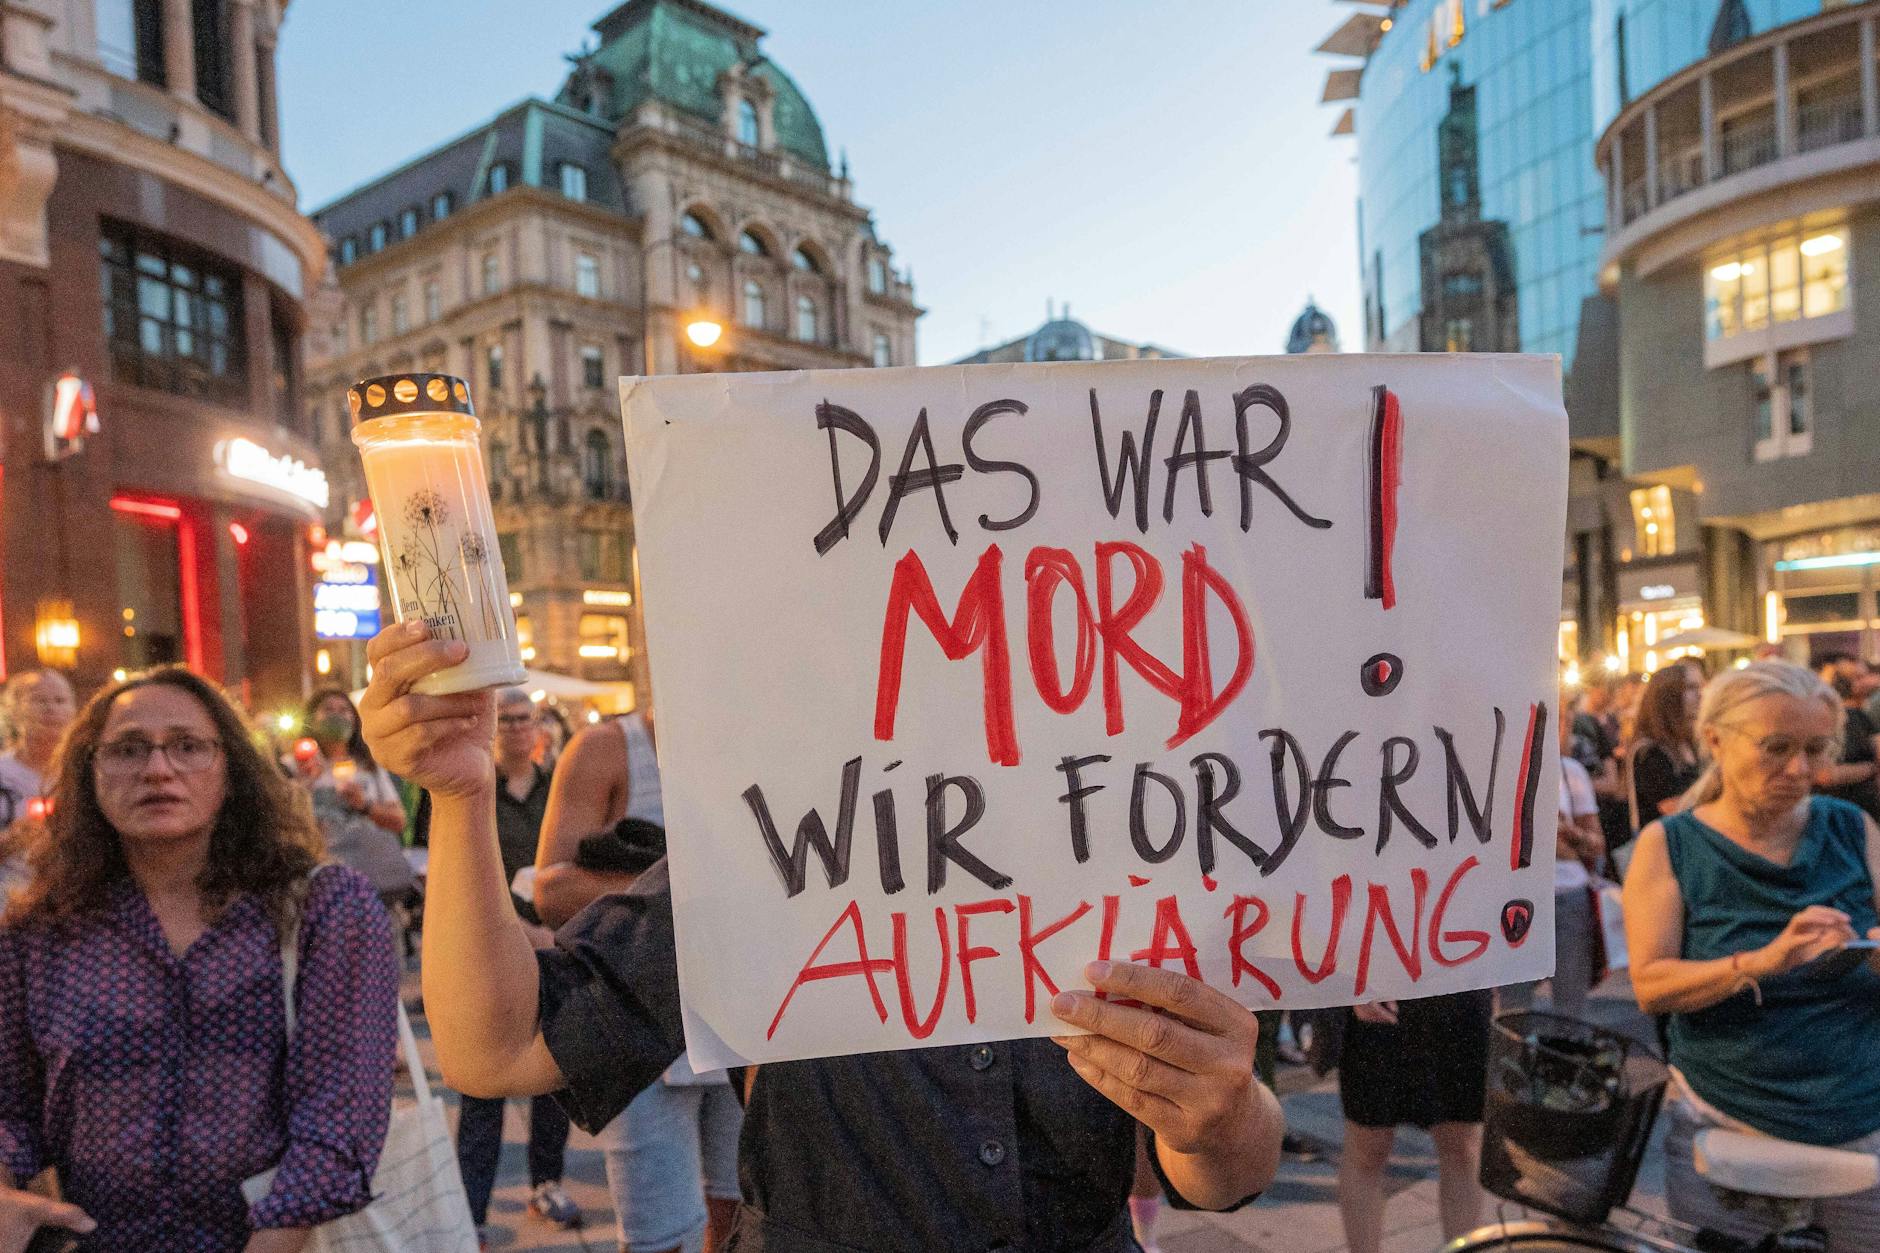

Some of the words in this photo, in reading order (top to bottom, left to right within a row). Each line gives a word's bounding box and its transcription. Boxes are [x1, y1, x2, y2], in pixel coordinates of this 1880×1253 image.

[805, 397, 1041, 556] DAS
[1089, 383, 1334, 534] WAR
[874, 540, 1256, 768] MORD
